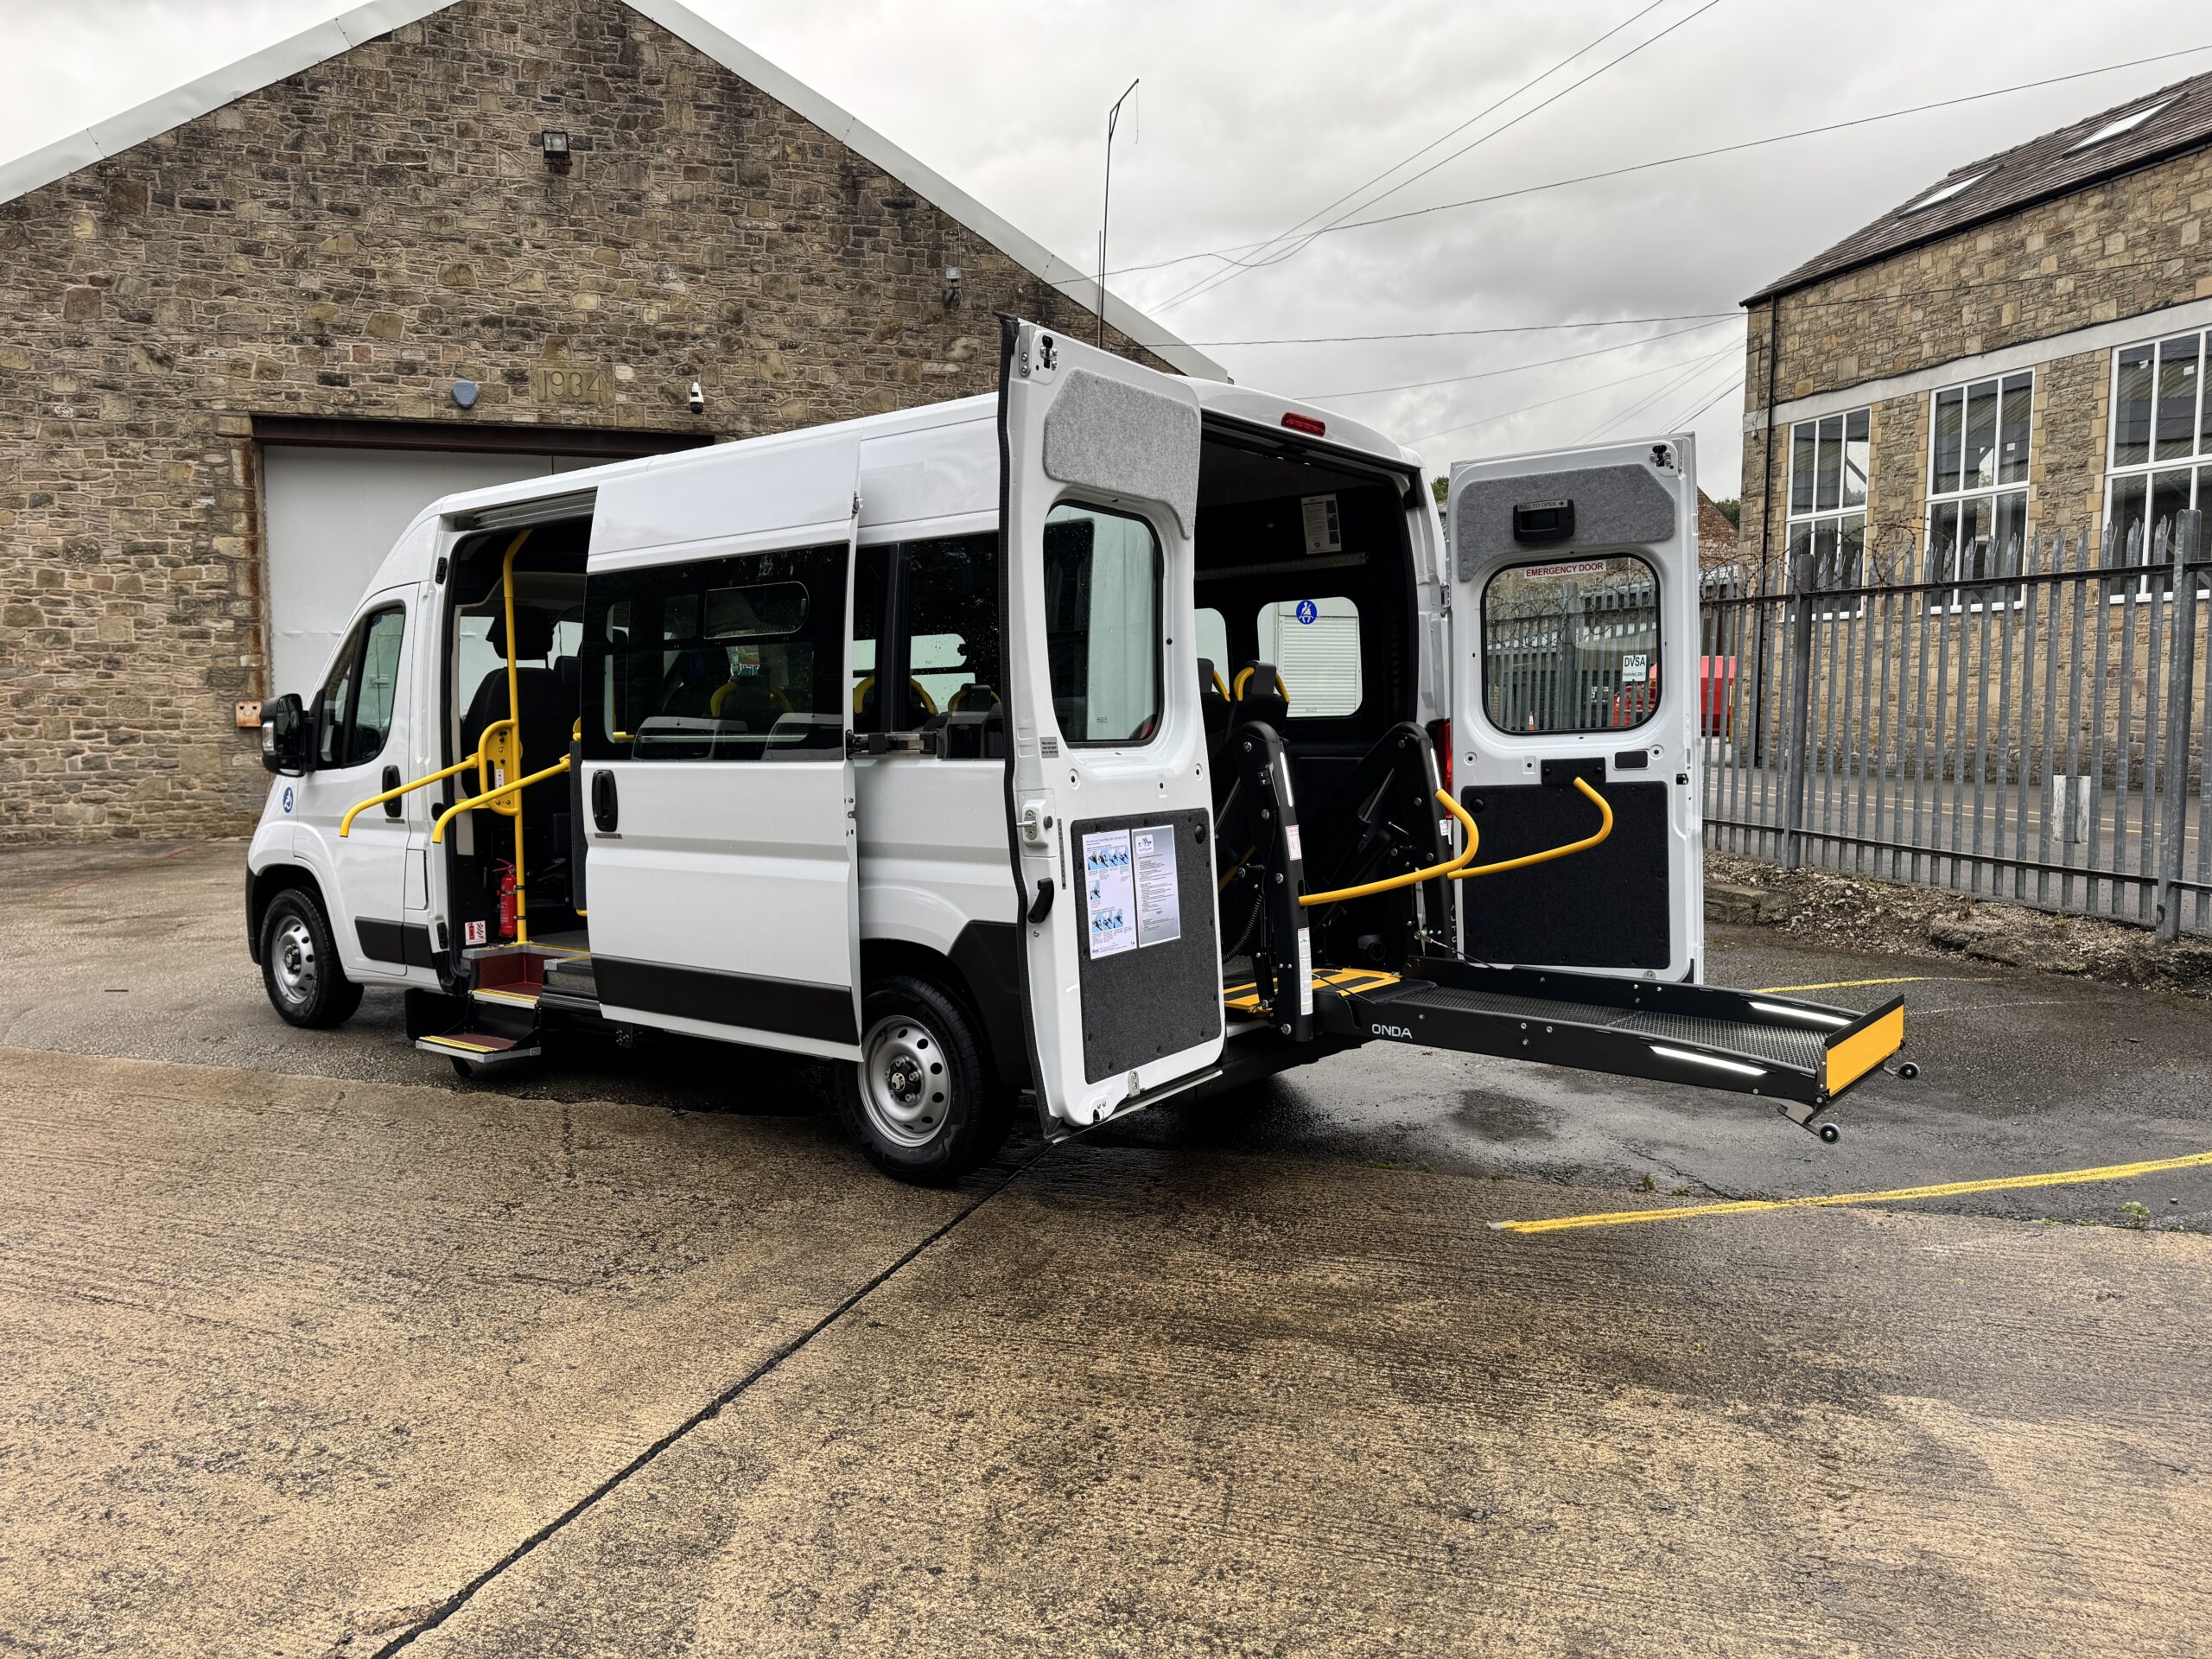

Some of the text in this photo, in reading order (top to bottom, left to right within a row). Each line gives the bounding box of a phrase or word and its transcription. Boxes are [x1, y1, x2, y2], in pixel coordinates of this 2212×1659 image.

[543, 370, 604, 403] 1934
[1526, 563, 1604, 576] EMERGENCY DOOR
[1624, 657, 1645, 667] DVSA
[1371, 1023, 1413, 1039] ONDA
